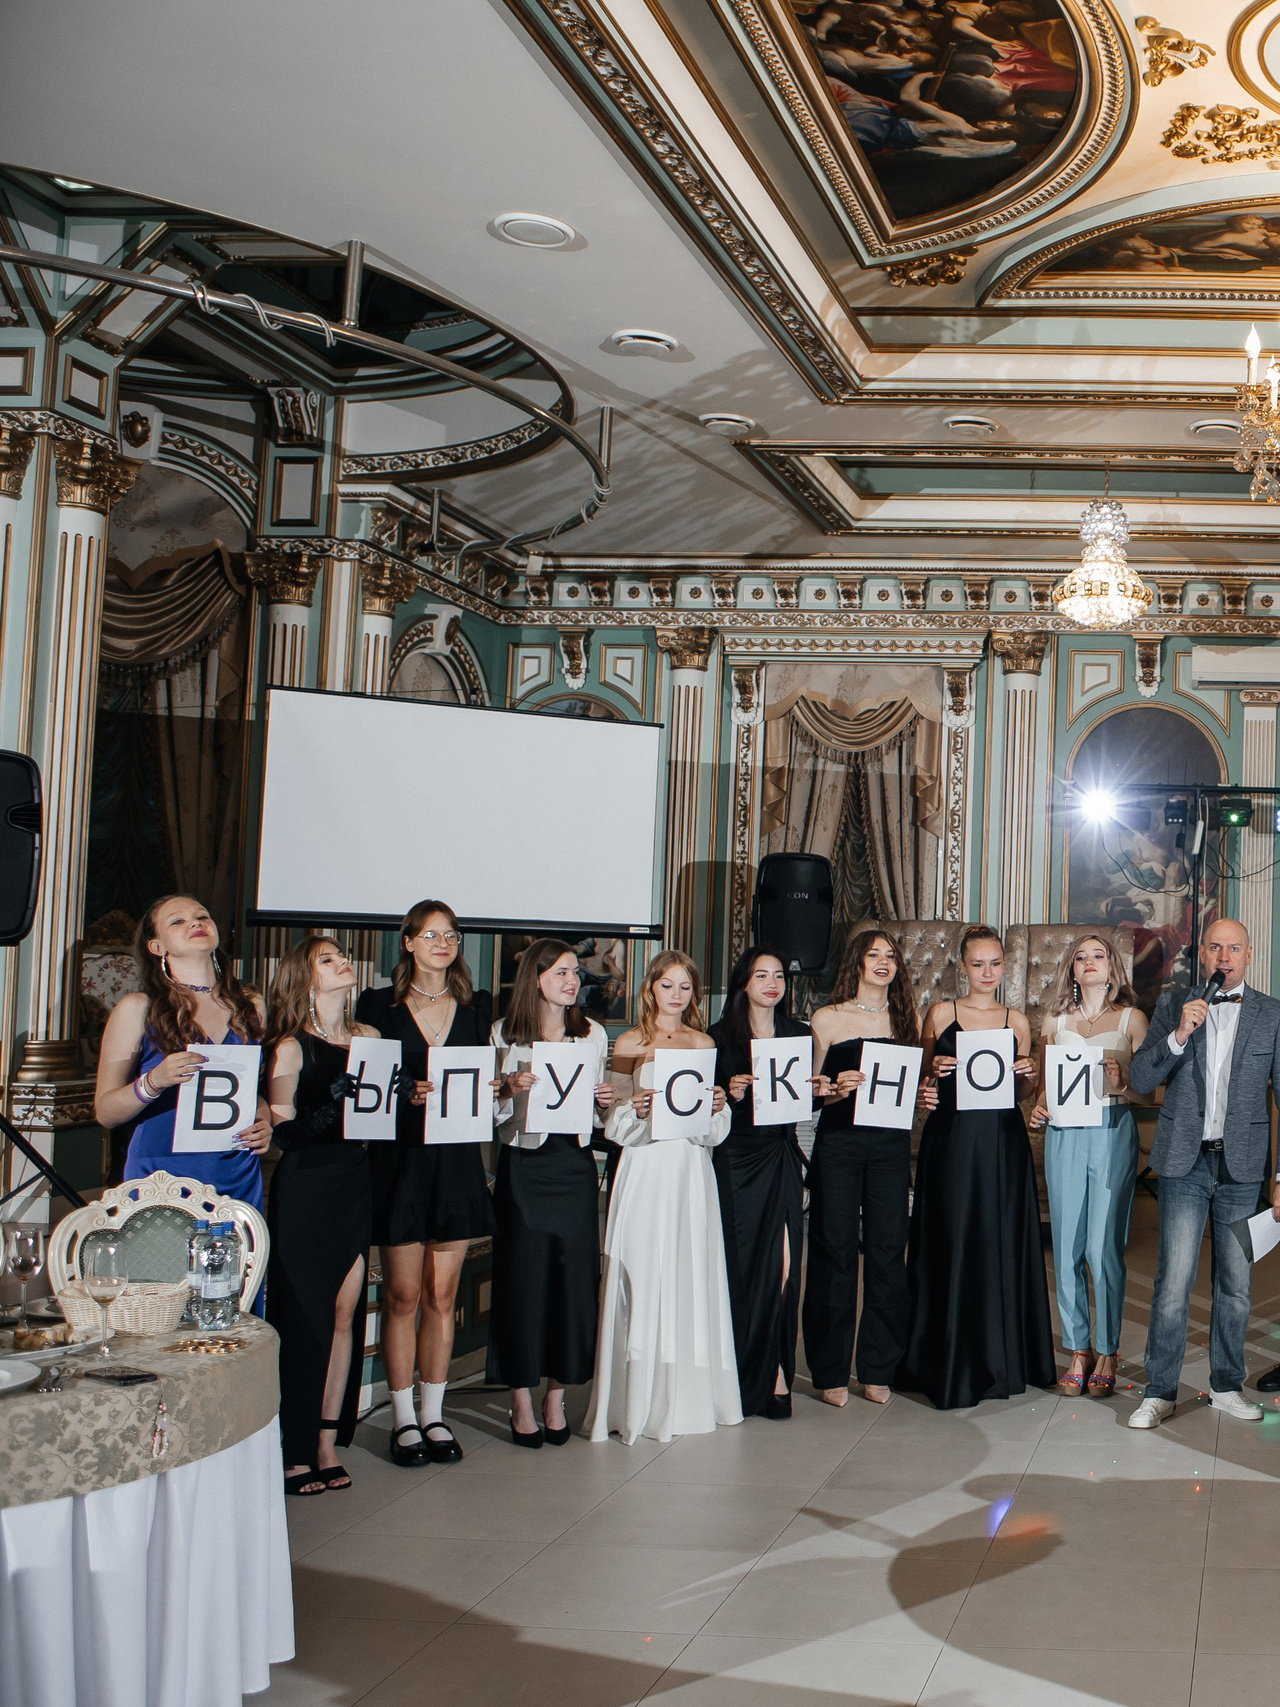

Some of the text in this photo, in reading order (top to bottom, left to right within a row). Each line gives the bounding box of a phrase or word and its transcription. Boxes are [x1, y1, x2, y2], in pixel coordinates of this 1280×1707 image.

[353, 1060, 399, 1115] Ы
[440, 1067, 479, 1118] П
[545, 1063, 584, 1109] У
[665, 1069, 704, 1117] С
[769, 1056, 800, 1103] К
[868, 1062, 907, 1107] Н
[965, 1049, 1005, 1092] О
[1057, 1054, 1091, 1105] Й
[192, 1070, 240, 1131] В
